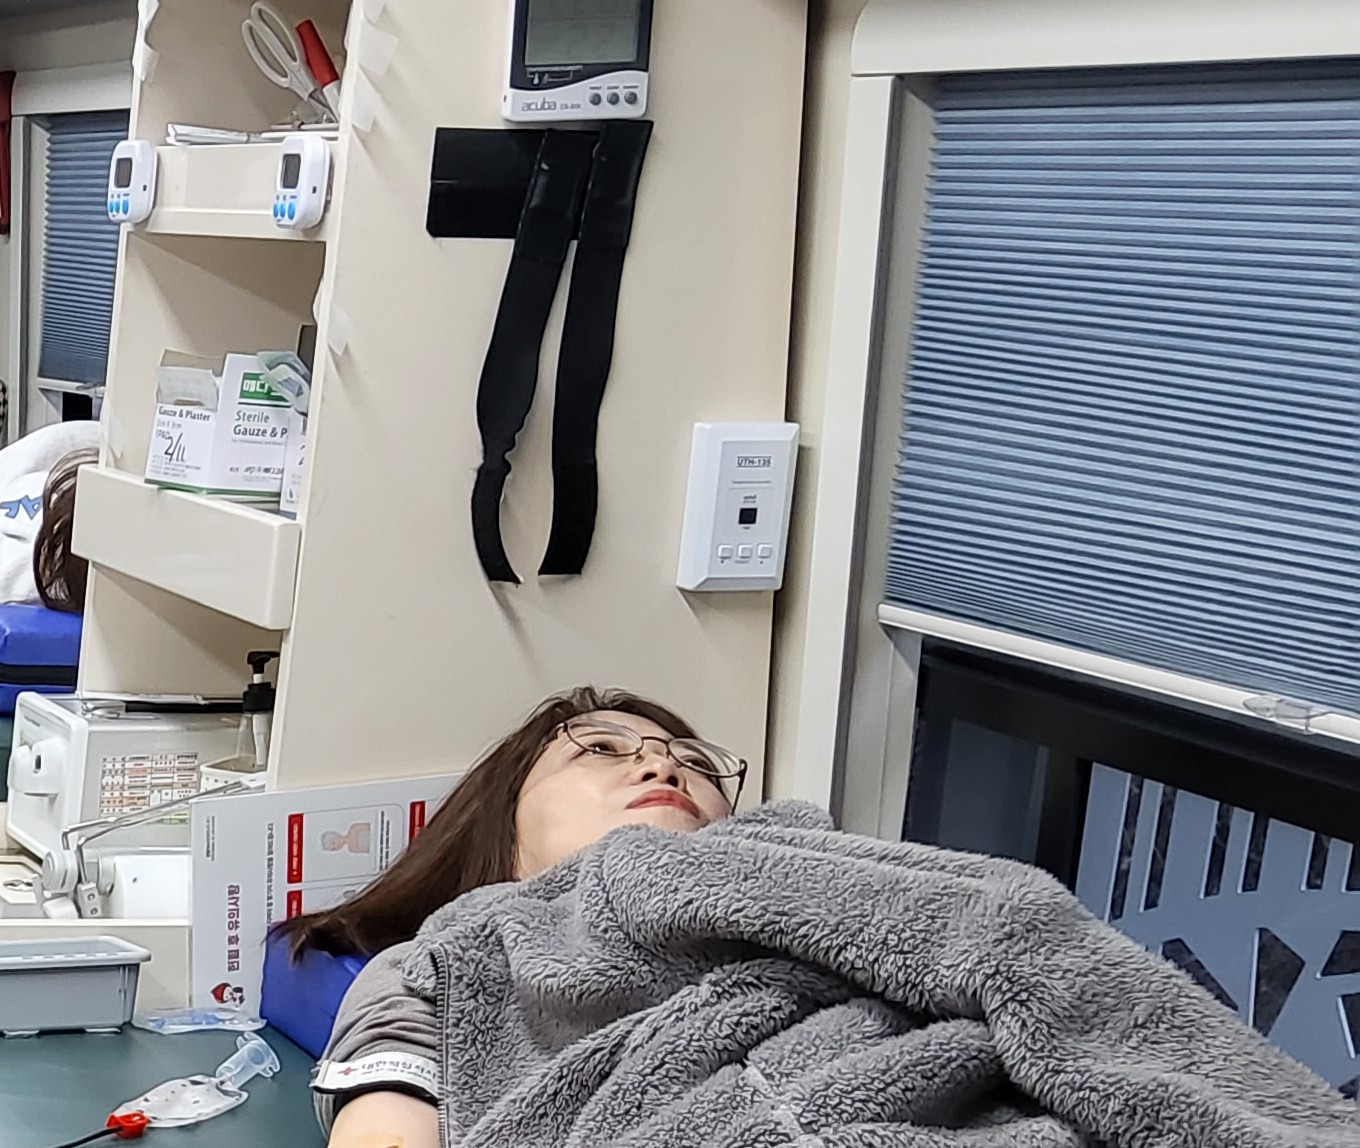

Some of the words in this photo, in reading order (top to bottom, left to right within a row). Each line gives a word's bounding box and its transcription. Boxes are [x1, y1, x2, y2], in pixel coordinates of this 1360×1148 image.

[159, 406, 177, 418] Gauze
[185, 410, 211, 421] Plaster
[235, 409, 270, 423] Sterile
[233, 424, 267, 437] Gauze
[270, 426, 278, 438] &
[227, 884, 240, 931] 유의사항
[227, 934, 240, 946] 후
[227, 949, 240, 972] 헌혈
